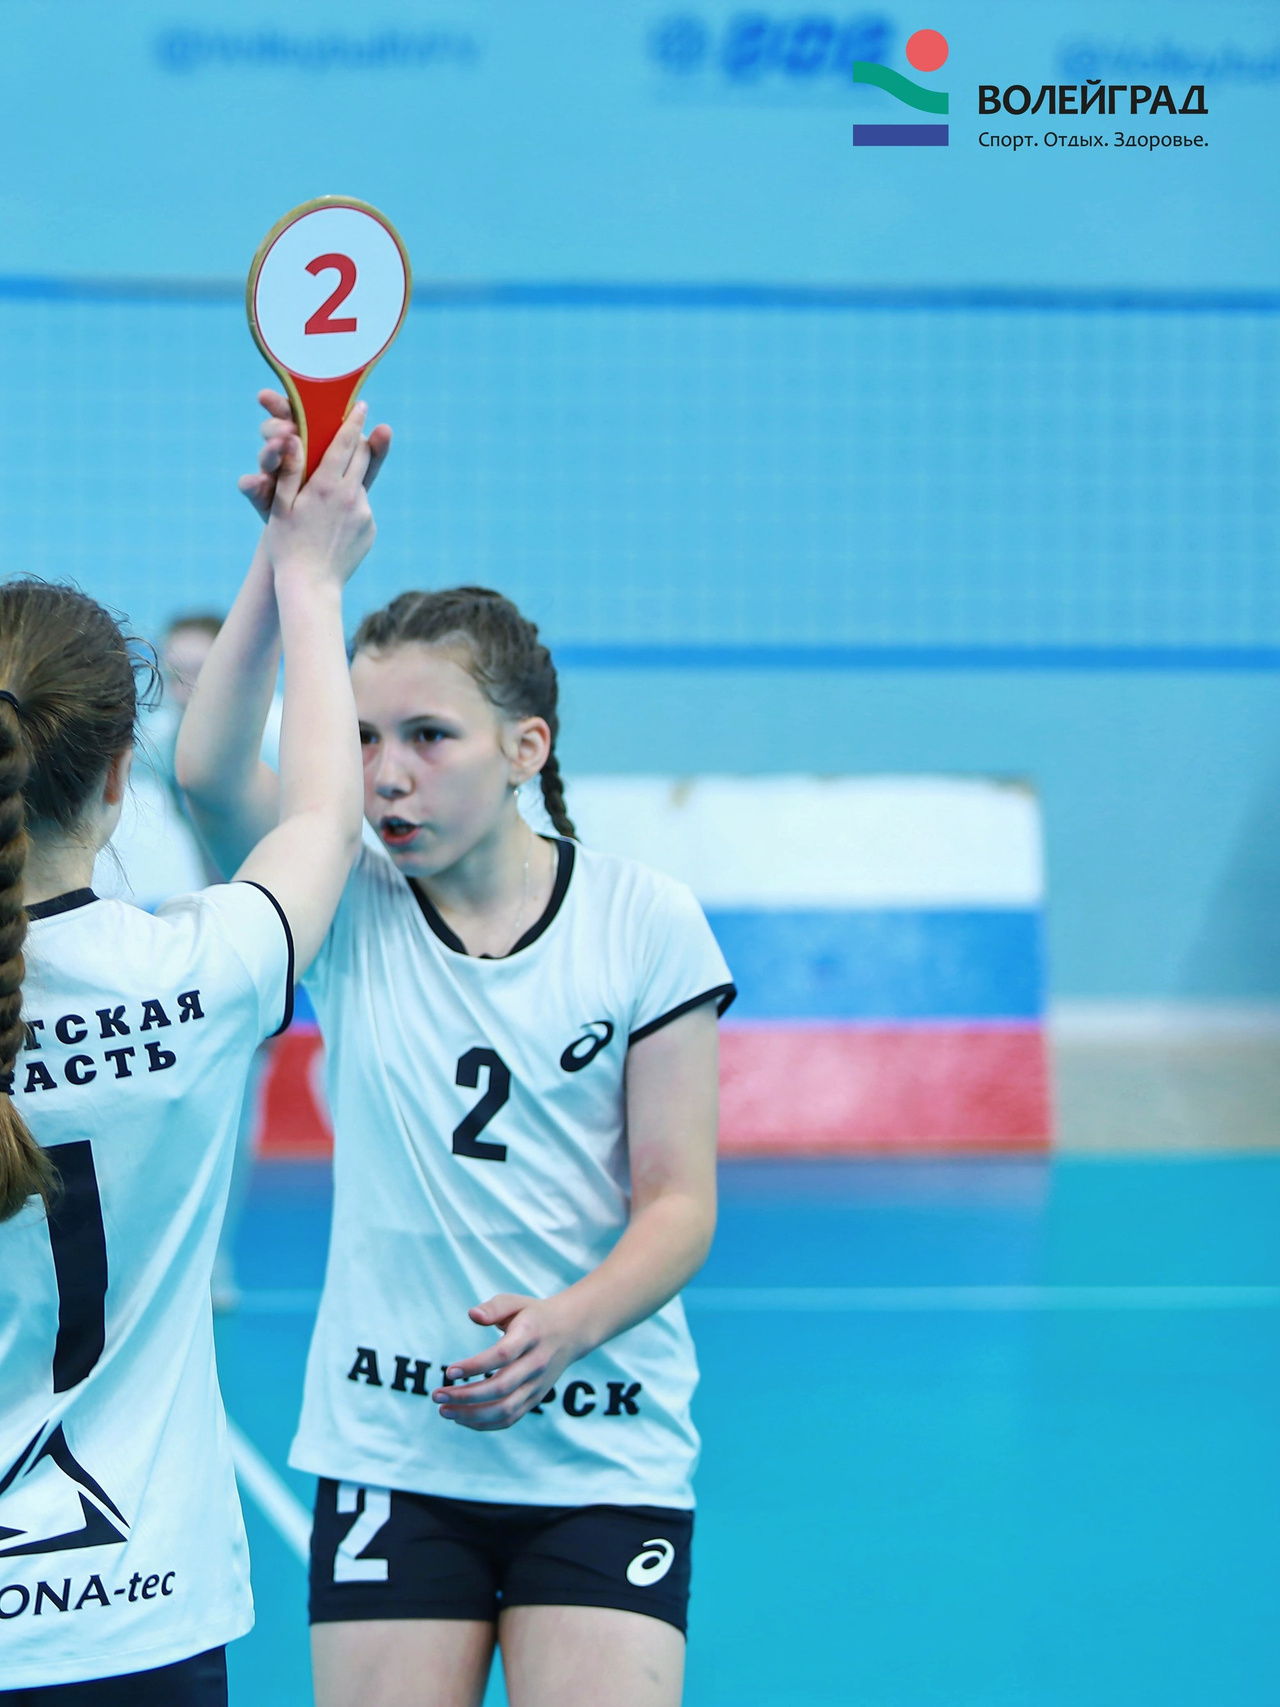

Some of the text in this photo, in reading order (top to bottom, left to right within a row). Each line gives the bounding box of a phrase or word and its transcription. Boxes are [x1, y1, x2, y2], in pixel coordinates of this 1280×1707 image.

[304, 252, 358, 335] 2
[452, 1047, 511, 1162] 2
[348, 1347, 643, 1417] АНСК
[333, 1482, 392, 1583] 2
